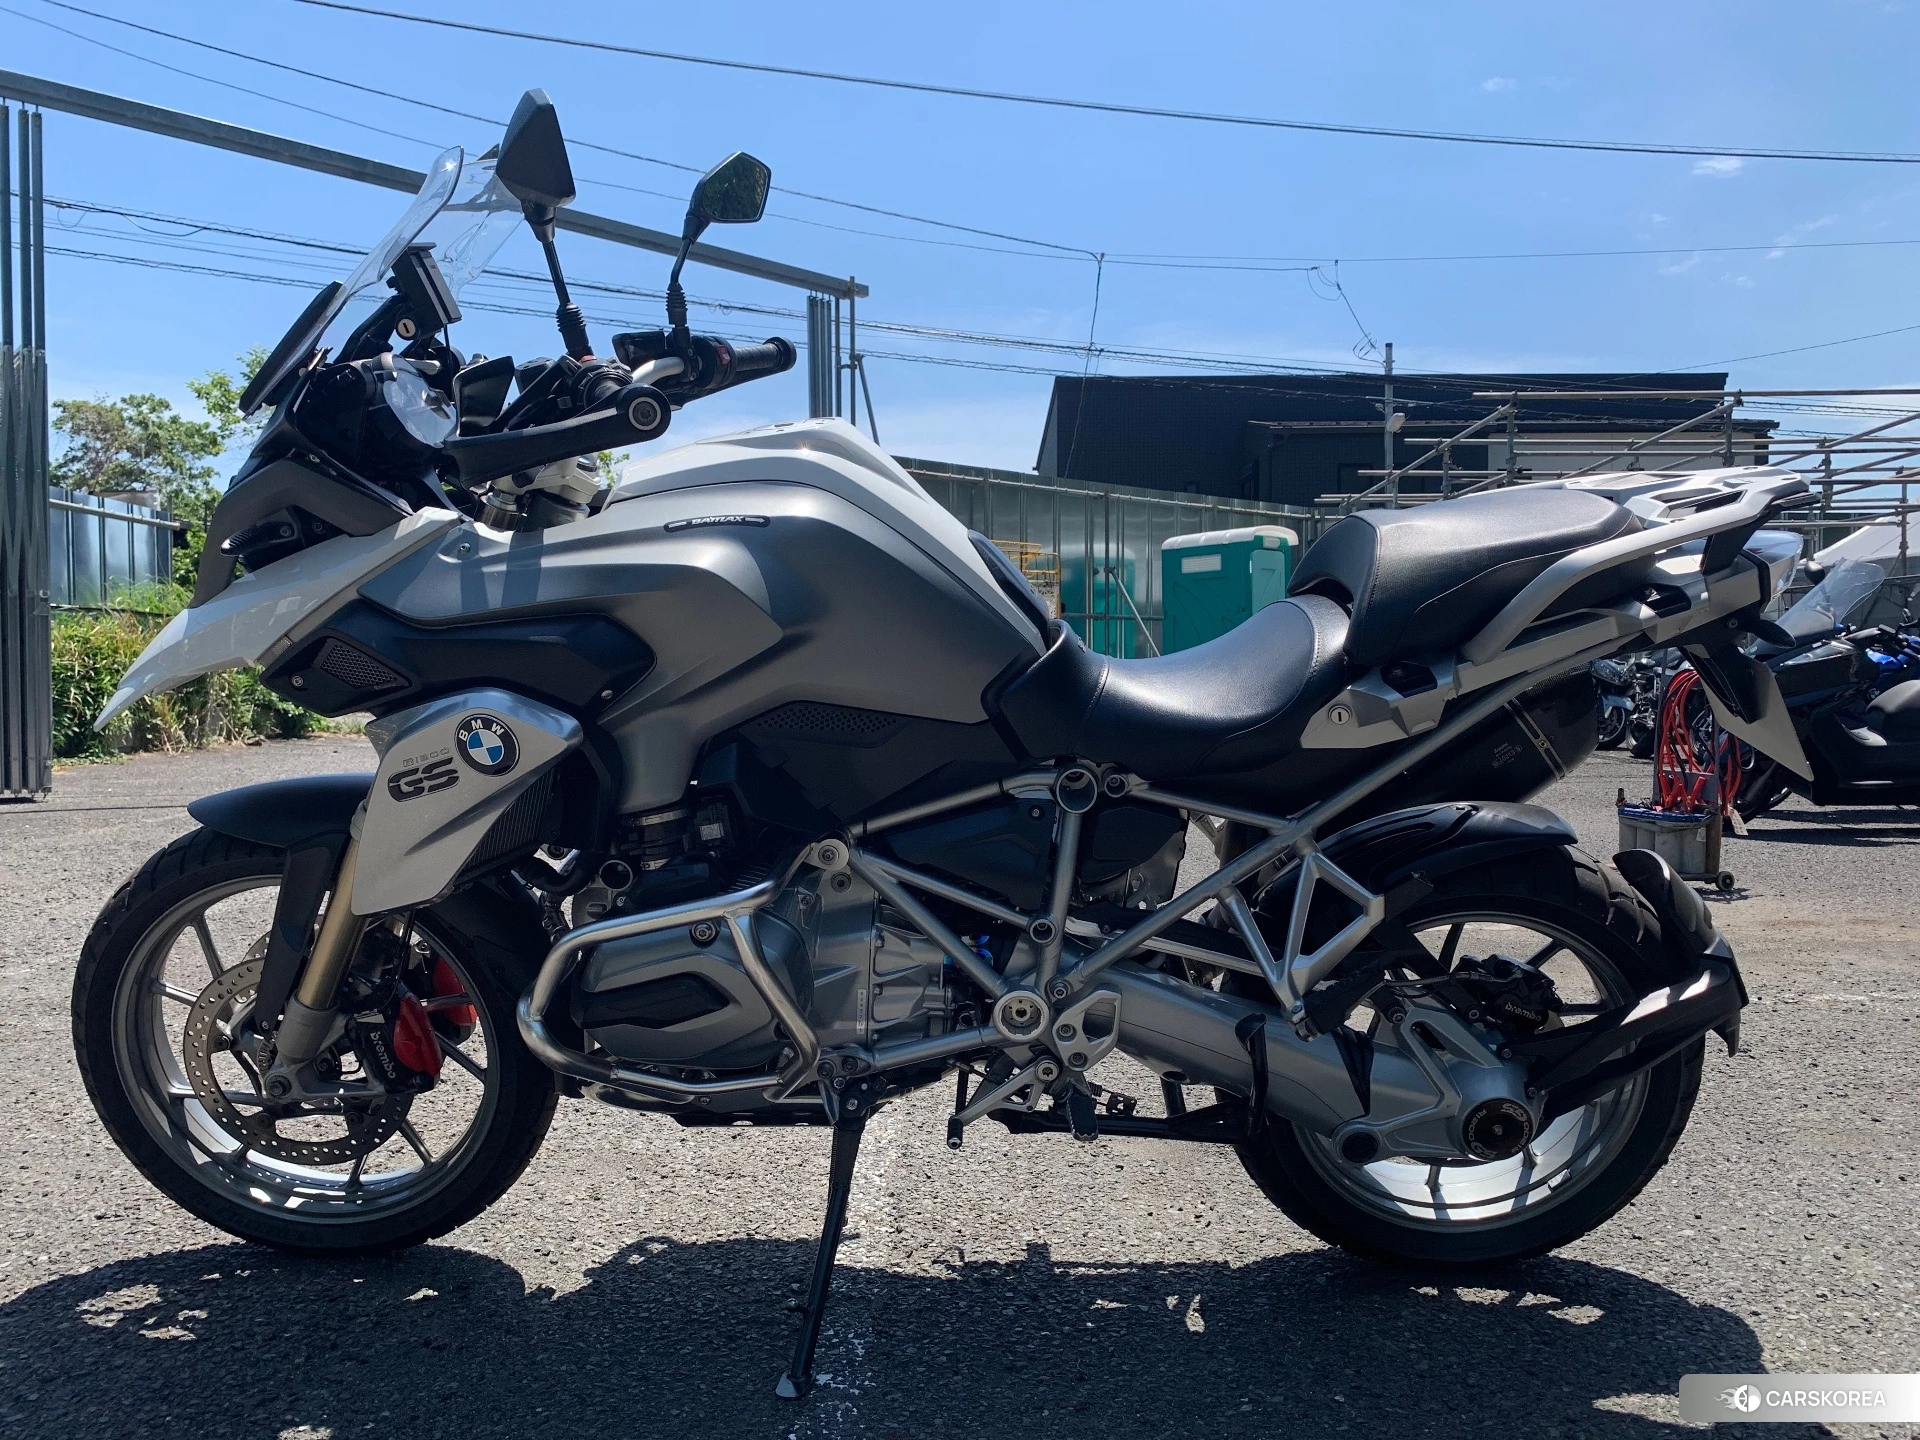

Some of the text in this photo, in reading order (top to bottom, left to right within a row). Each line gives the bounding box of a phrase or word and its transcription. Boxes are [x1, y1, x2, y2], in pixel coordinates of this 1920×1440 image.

[458, 719, 505, 742] BMW
[402, 747, 451, 768] R1200
[387, 757, 460, 803] GS
[1504, 1001, 1542, 1022] brembo
[369, 1031, 397, 1079] brembo
[1500, 1102, 1528, 1122] GS
[1468, 1108, 1487, 1141] R1200
